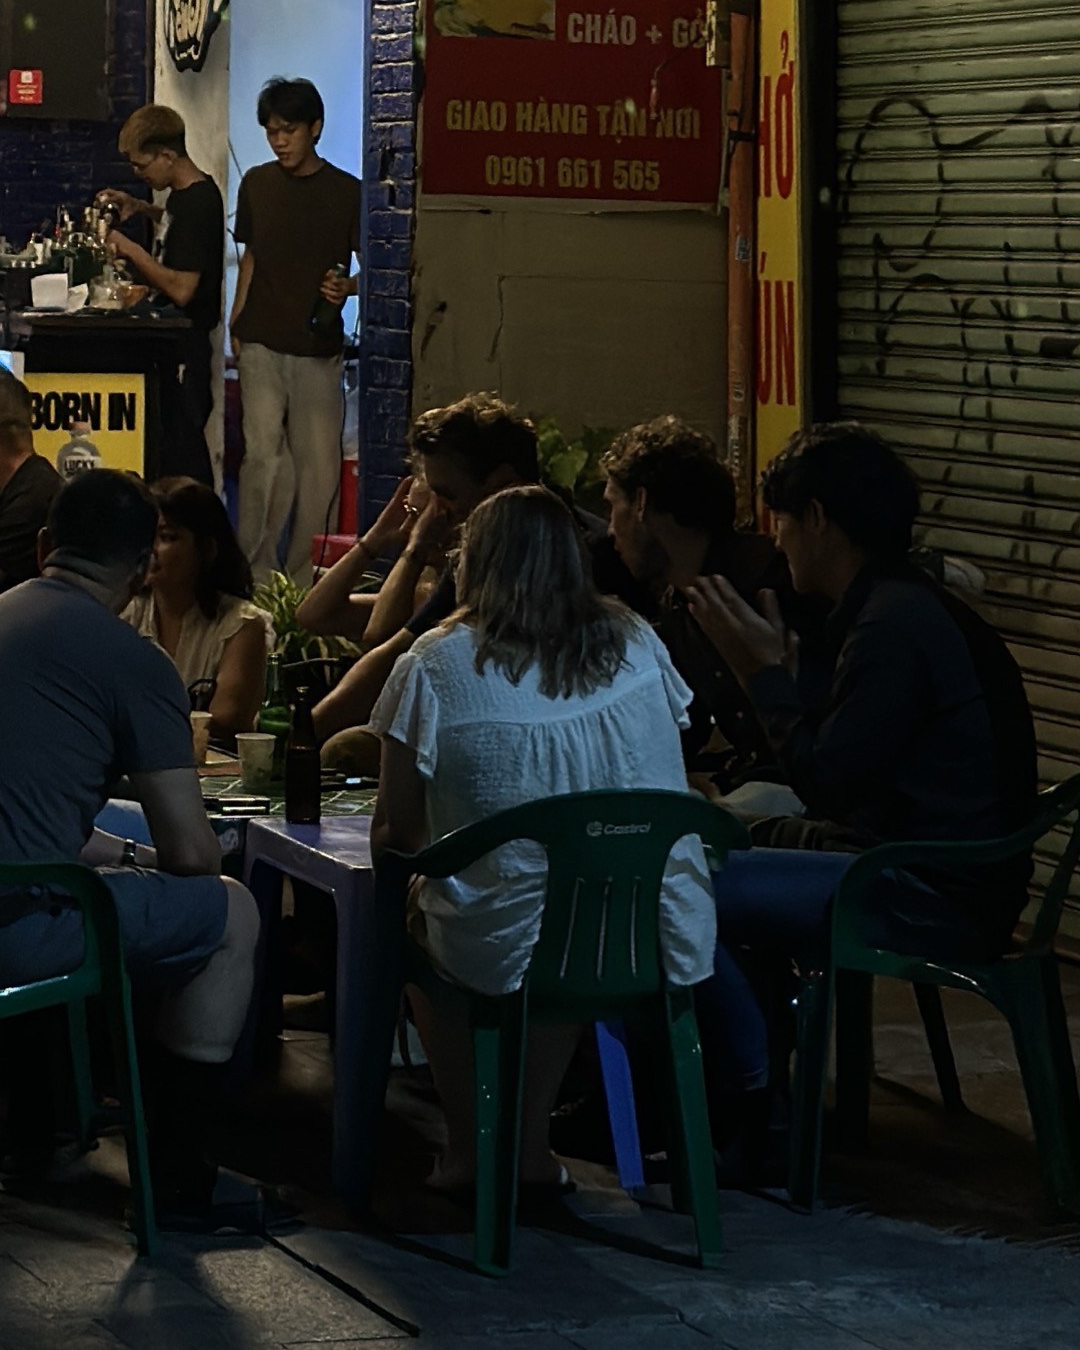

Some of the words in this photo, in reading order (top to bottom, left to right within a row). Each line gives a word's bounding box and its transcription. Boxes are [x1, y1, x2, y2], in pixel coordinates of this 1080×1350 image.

[567, 8, 637, 46] CHÁO
[672, 7, 708, 49] GỎ
[445, 99, 507, 132] GIAO
[515, 96, 588, 135] HÀNG
[596, 99, 647, 144] TẬN
[656, 106, 701, 140] NƠI
[757, 30, 795, 199] HỞ
[485, 154, 546, 188] 0961
[557, 156, 602, 190] 661
[613, 159, 661, 191] 565
[757, 251, 796, 406] ÚN
[31, 392, 101, 431] BORN
[108, 393, 136, 431] IN
